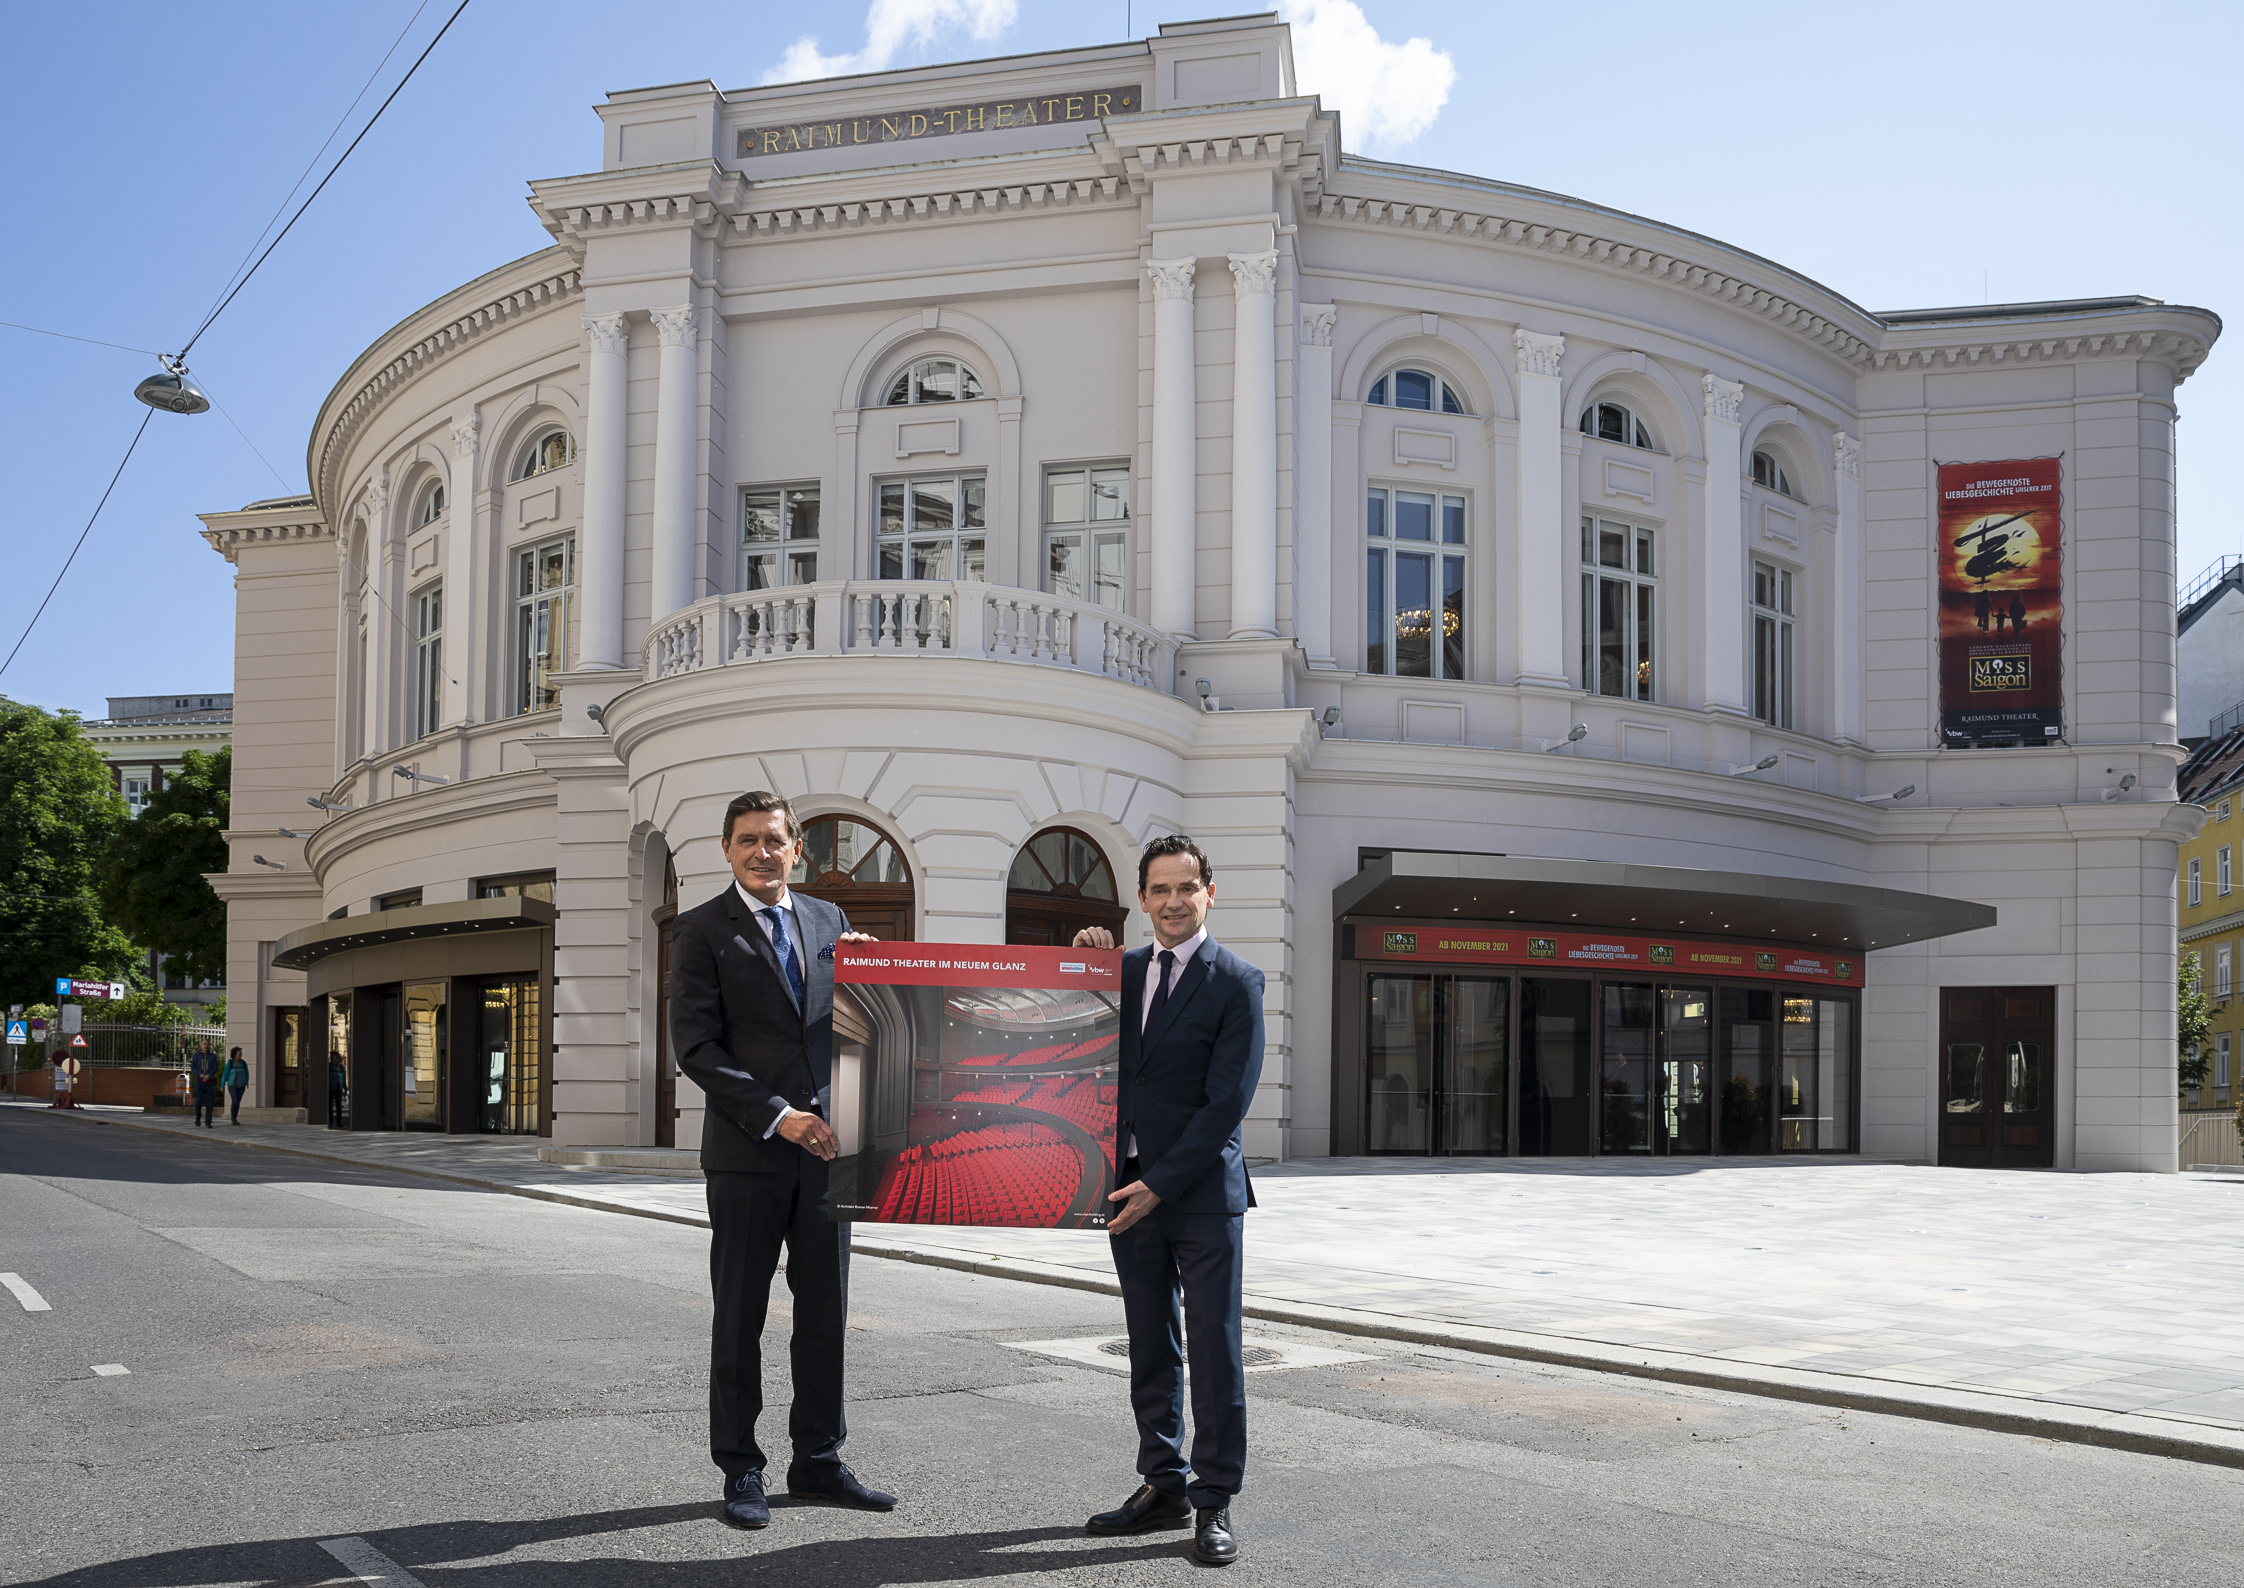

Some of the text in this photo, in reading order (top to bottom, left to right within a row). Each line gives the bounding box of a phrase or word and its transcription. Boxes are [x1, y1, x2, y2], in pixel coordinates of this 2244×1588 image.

[762, 93, 1113, 153] RAIMUND-THEATER
[1976, 477, 2031, 489] BEWEGENDSTE
[1945, 484, 2053, 500] LIEBESGESCHICHTE UNSERER ZEIT
[1974, 673, 2027, 690] Saigon
[1961, 712, 2041, 724] RAIMUND THEATER
[1386, 942, 1415, 953] Saigon
[1438, 940, 1509, 952] AB NOVEMBER 2021
[1530, 947, 1555, 958] Saigon
[842, 957, 1027, 971] RAIMUND THEATER IM NEUEM GLANZ
[1651, 954, 1673, 965] Saigon
[1690, 953, 1742, 965] AB NOVEMBER 2021
[72, 980, 109, 991] Mariahilfer
[79, 988, 102, 997] Straße
